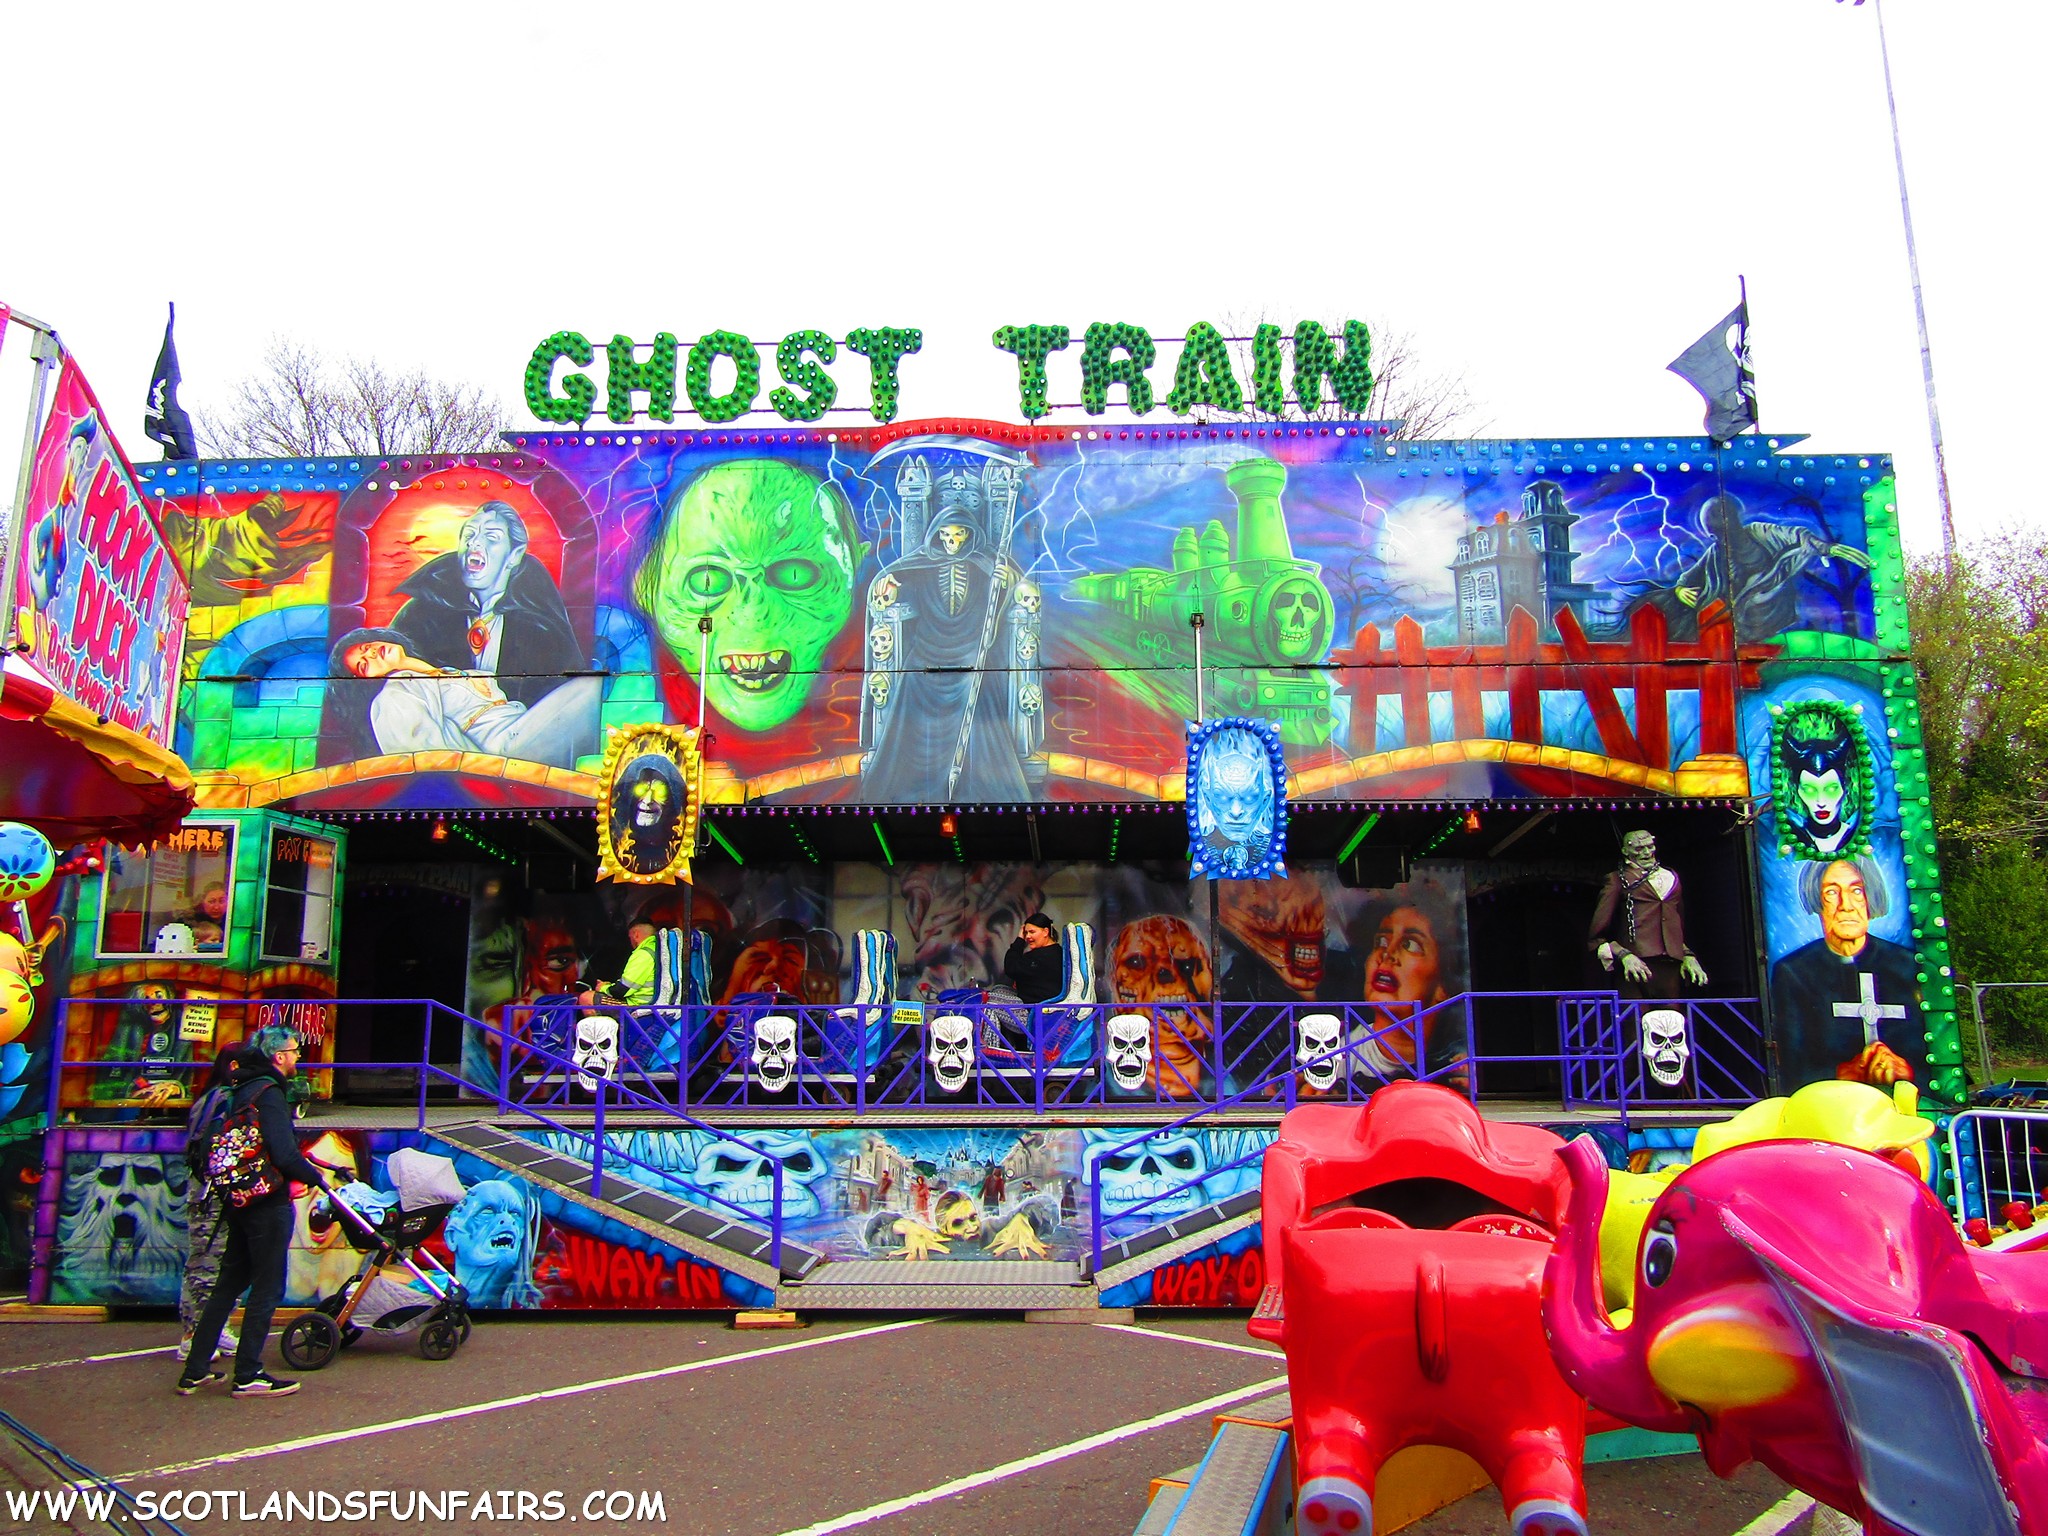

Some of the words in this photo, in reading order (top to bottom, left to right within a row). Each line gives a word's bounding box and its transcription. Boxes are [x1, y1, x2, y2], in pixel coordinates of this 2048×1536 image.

[525, 326, 922, 424] GHOST
[993, 320, 1376, 419] TRAIN
[77, 452, 155, 603] HOOK
[136, 541, 165, 627] A
[71, 556, 139, 692] DUCK
[169, 828, 225, 853] HERE
[277, 837, 302, 862] PAY
[544, 1130, 637, 1169] WAY
[641, 1130, 699, 1174] IN
[571, 1236, 663, 1299] WAY
[676, 1259, 721, 1300] IN
[1153, 1253, 1230, 1303] WAY
